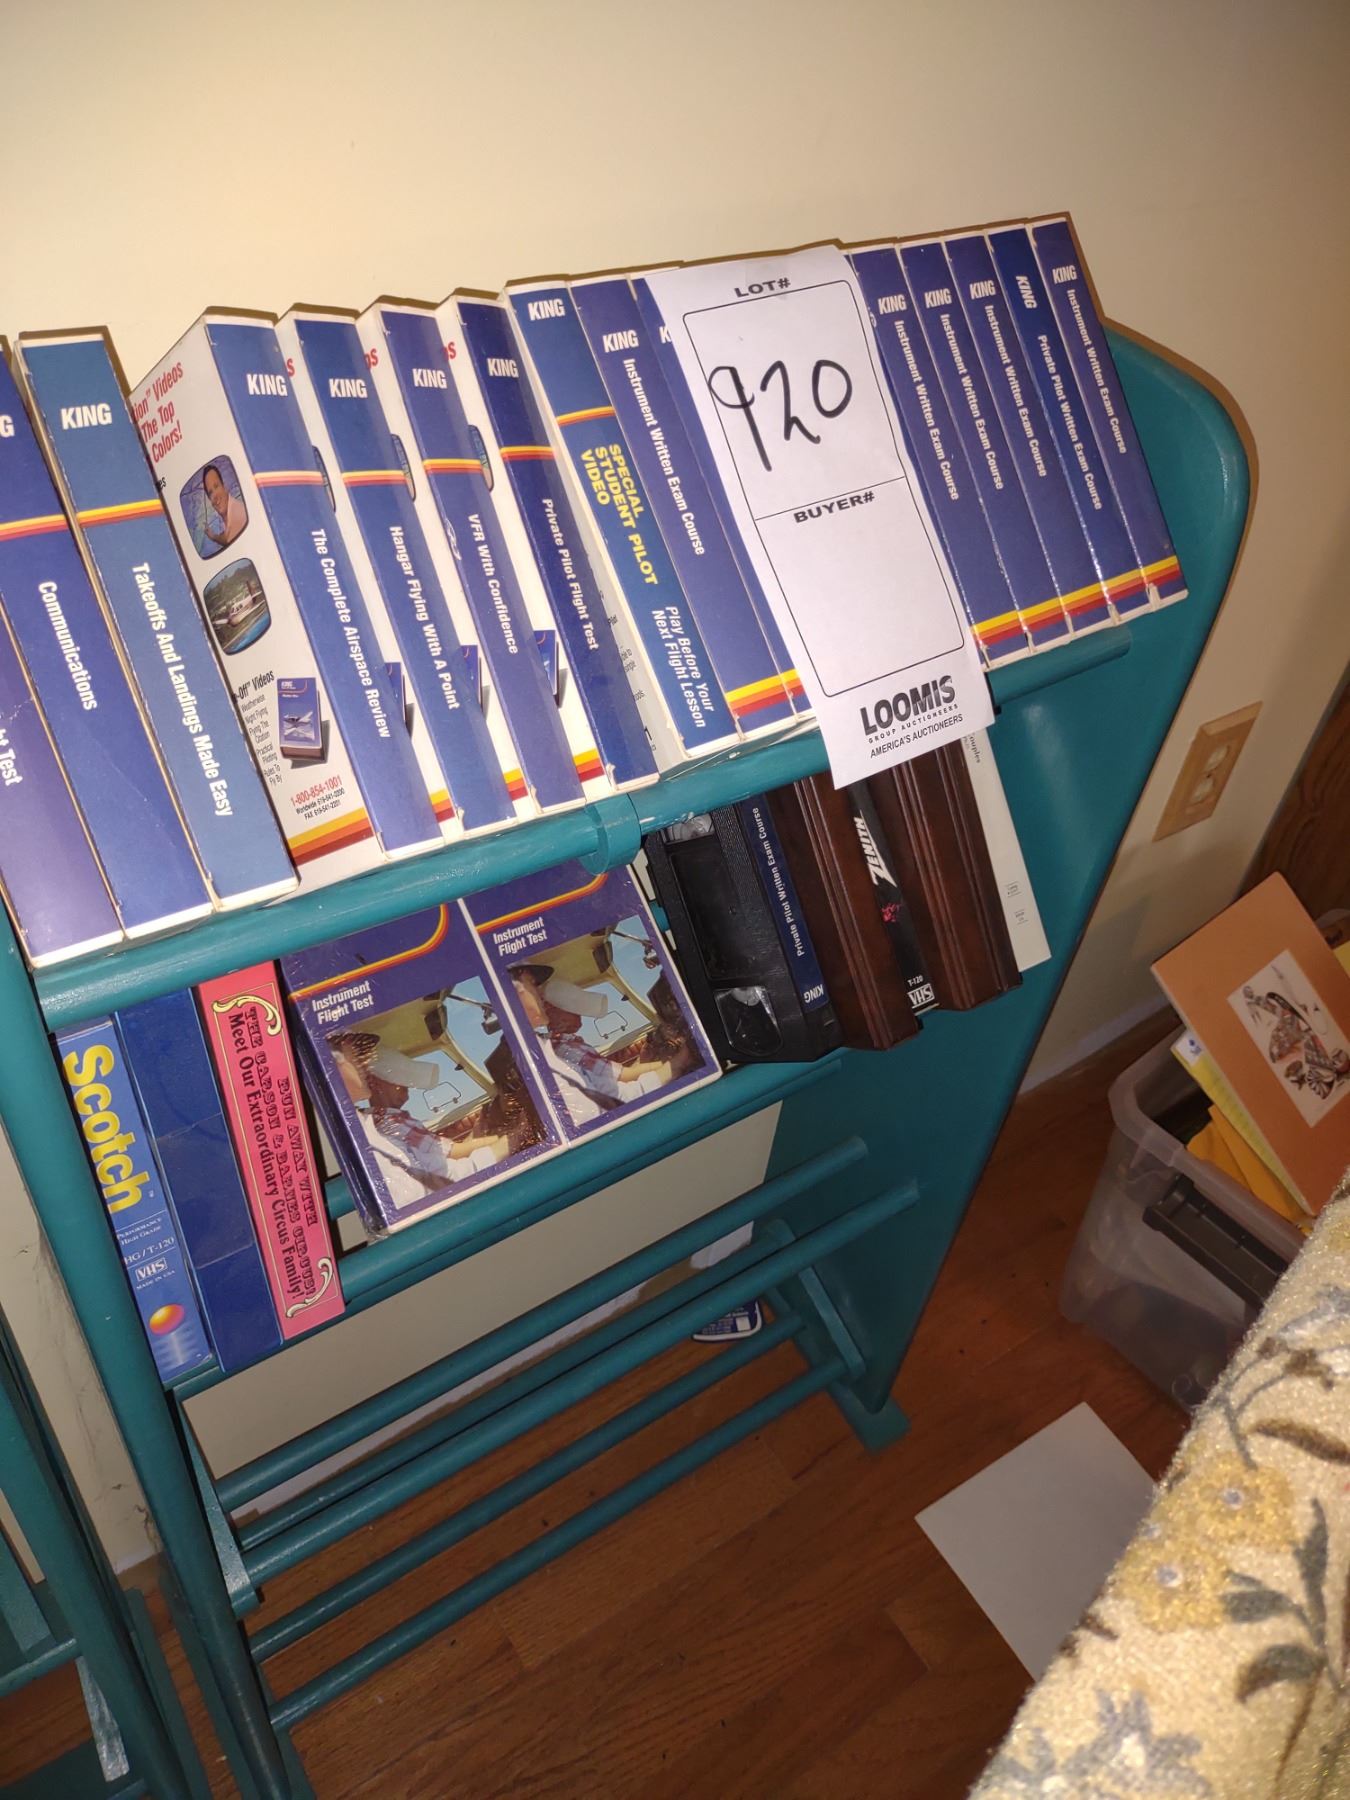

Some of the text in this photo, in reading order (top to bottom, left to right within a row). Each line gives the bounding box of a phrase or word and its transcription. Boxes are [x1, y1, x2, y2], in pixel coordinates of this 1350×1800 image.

[734, 277, 791, 298] LOT#
[969, 280, 996, 300] KING
[1015, 275, 1037, 309] KING
[1052, 265, 1077, 285] KING
[528, 299, 565, 321] KING
[878, 294, 907, 315] KING
[924, 288, 952, 309] KING
[602, 330, 639, 353] KING
[152, 361, 183, 402] Videos
[247, 373, 288, 396] KING
[412, 368, 447, 390] KING
[487, 357, 519, 378] KING
[1066, 289, 1127, 454] Instrument Written Exam Course
[329, 378, 368, 399] KING
[940, 314, 1004, 491] Instrument Written Exam Course
[985, 305, 1048, 478] Instrument Written Exam Course
[61, 403, 112, 430] KING
[141, 401, 175, 443] The Top
[708, 359, 852, 472] 920
[894, 320, 960, 501] Instrument Written Exam Course
[1037, 335, 1102, 512] Private Pilot Written Exam Course
[151, 420, 183, 463] Colors!
[623, 358, 705, 556] Instrument Written Exam Course
[580, 449, 610, 506] VIDEO
[609, 443, 644, 518] SPECIAL
[595, 446, 658, 585] STUDENT PILOT
[793, 491, 874, 524] BUYER#
[467, 514, 518, 655] VFR With Confidence
[542, 498, 598, 650] Private Pilot Flight Test
[311, 528, 391, 738] The Complete Airspace Review
[389, 526, 416, 579] Hangar
[407, 578, 430, 623] Flying
[422, 623, 441, 658] With
[438, 671, 460, 710] Point
[38, 581, 98, 711] Communications
[665, 605, 714, 712] Play Before Your
[131, 562, 233, 816] Takeoffs And Landings Made Easy
[252, 670, 275, 691] Videos
[651, 610, 706, 728] Next Flight Lesson
[860, 675, 955, 736] LOOMIS
[869, 704, 958, 743] GROUP AUCTIONEERS
[870, 713, 963, 758] AMERICA'S AUCTIONEERS
[0, 748, 23, 786] Test
[290, 775, 342, 807] 1-800-854-1001
[752, 807, 804, 956] Private Pilot Written Exam Course
[492, 916, 545, 945] Instrument
[498, 929, 548, 957] Flight Test
[311, 980, 371, 1012] Instrument
[804, 984, 824, 1004] KING
[907, 975, 923, 987] T-120
[908, 984, 934, 1009] VHS
[245, 1006, 263, 1049] THE
[317, 994, 375, 1025] Flight Test
[61, 1044, 151, 1214] Scotch
[229, 1013, 306, 1299] Meet Our Extraordinary Circus Family!
[278, 1076, 318, 1227] RUN AWAY WITH
[146, 1236, 175, 1254] T-120
[137, 1258, 167, 1281] VHS
